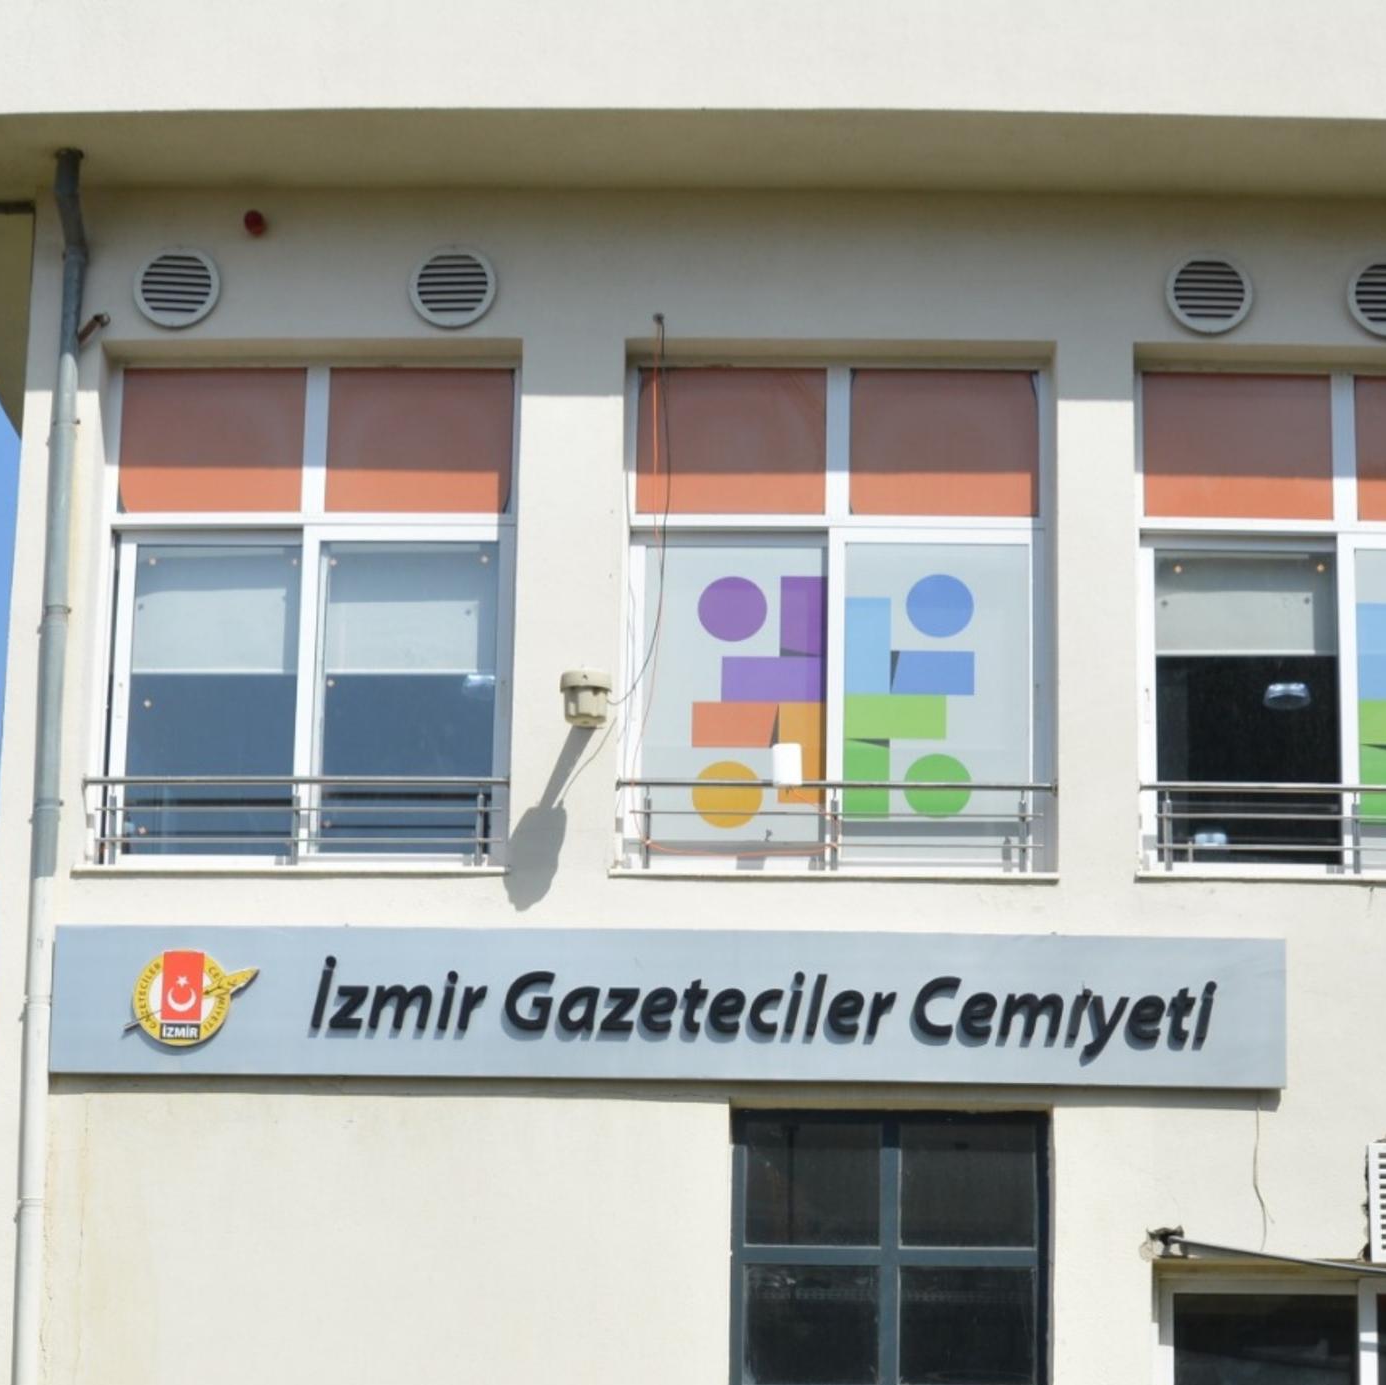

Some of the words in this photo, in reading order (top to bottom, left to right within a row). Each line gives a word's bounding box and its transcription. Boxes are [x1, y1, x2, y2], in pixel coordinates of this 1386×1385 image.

[162, 1023, 198, 1038] İZMİR
[310, 955, 488, 1032] İzmir
[504, 970, 898, 1037] Gazeteciler
[913, 976, 1218, 1060] Cemiyeti
